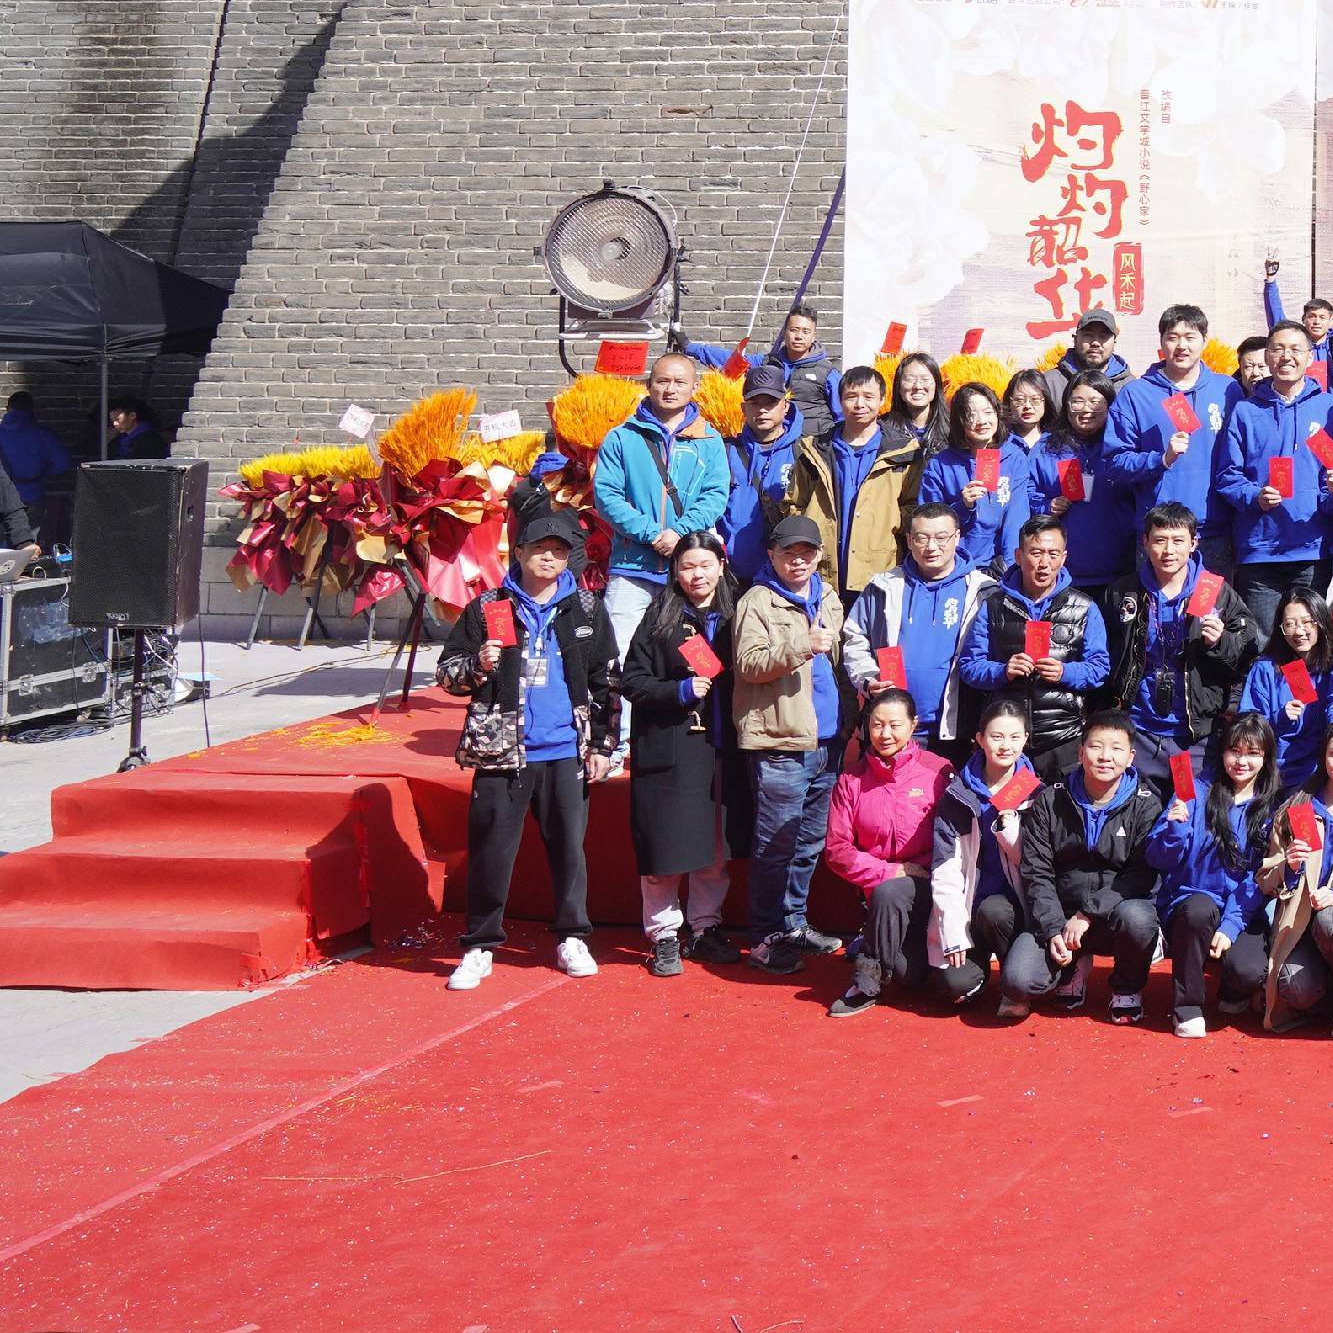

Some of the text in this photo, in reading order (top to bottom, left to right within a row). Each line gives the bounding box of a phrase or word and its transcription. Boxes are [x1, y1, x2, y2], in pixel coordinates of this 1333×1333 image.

[1021, 100, 1130, 340] 灼灼韶华
[1138, 89, 1152, 227] 晋江文学城小说《野心家》
[1119, 252, 1137, 309] 风禾起
